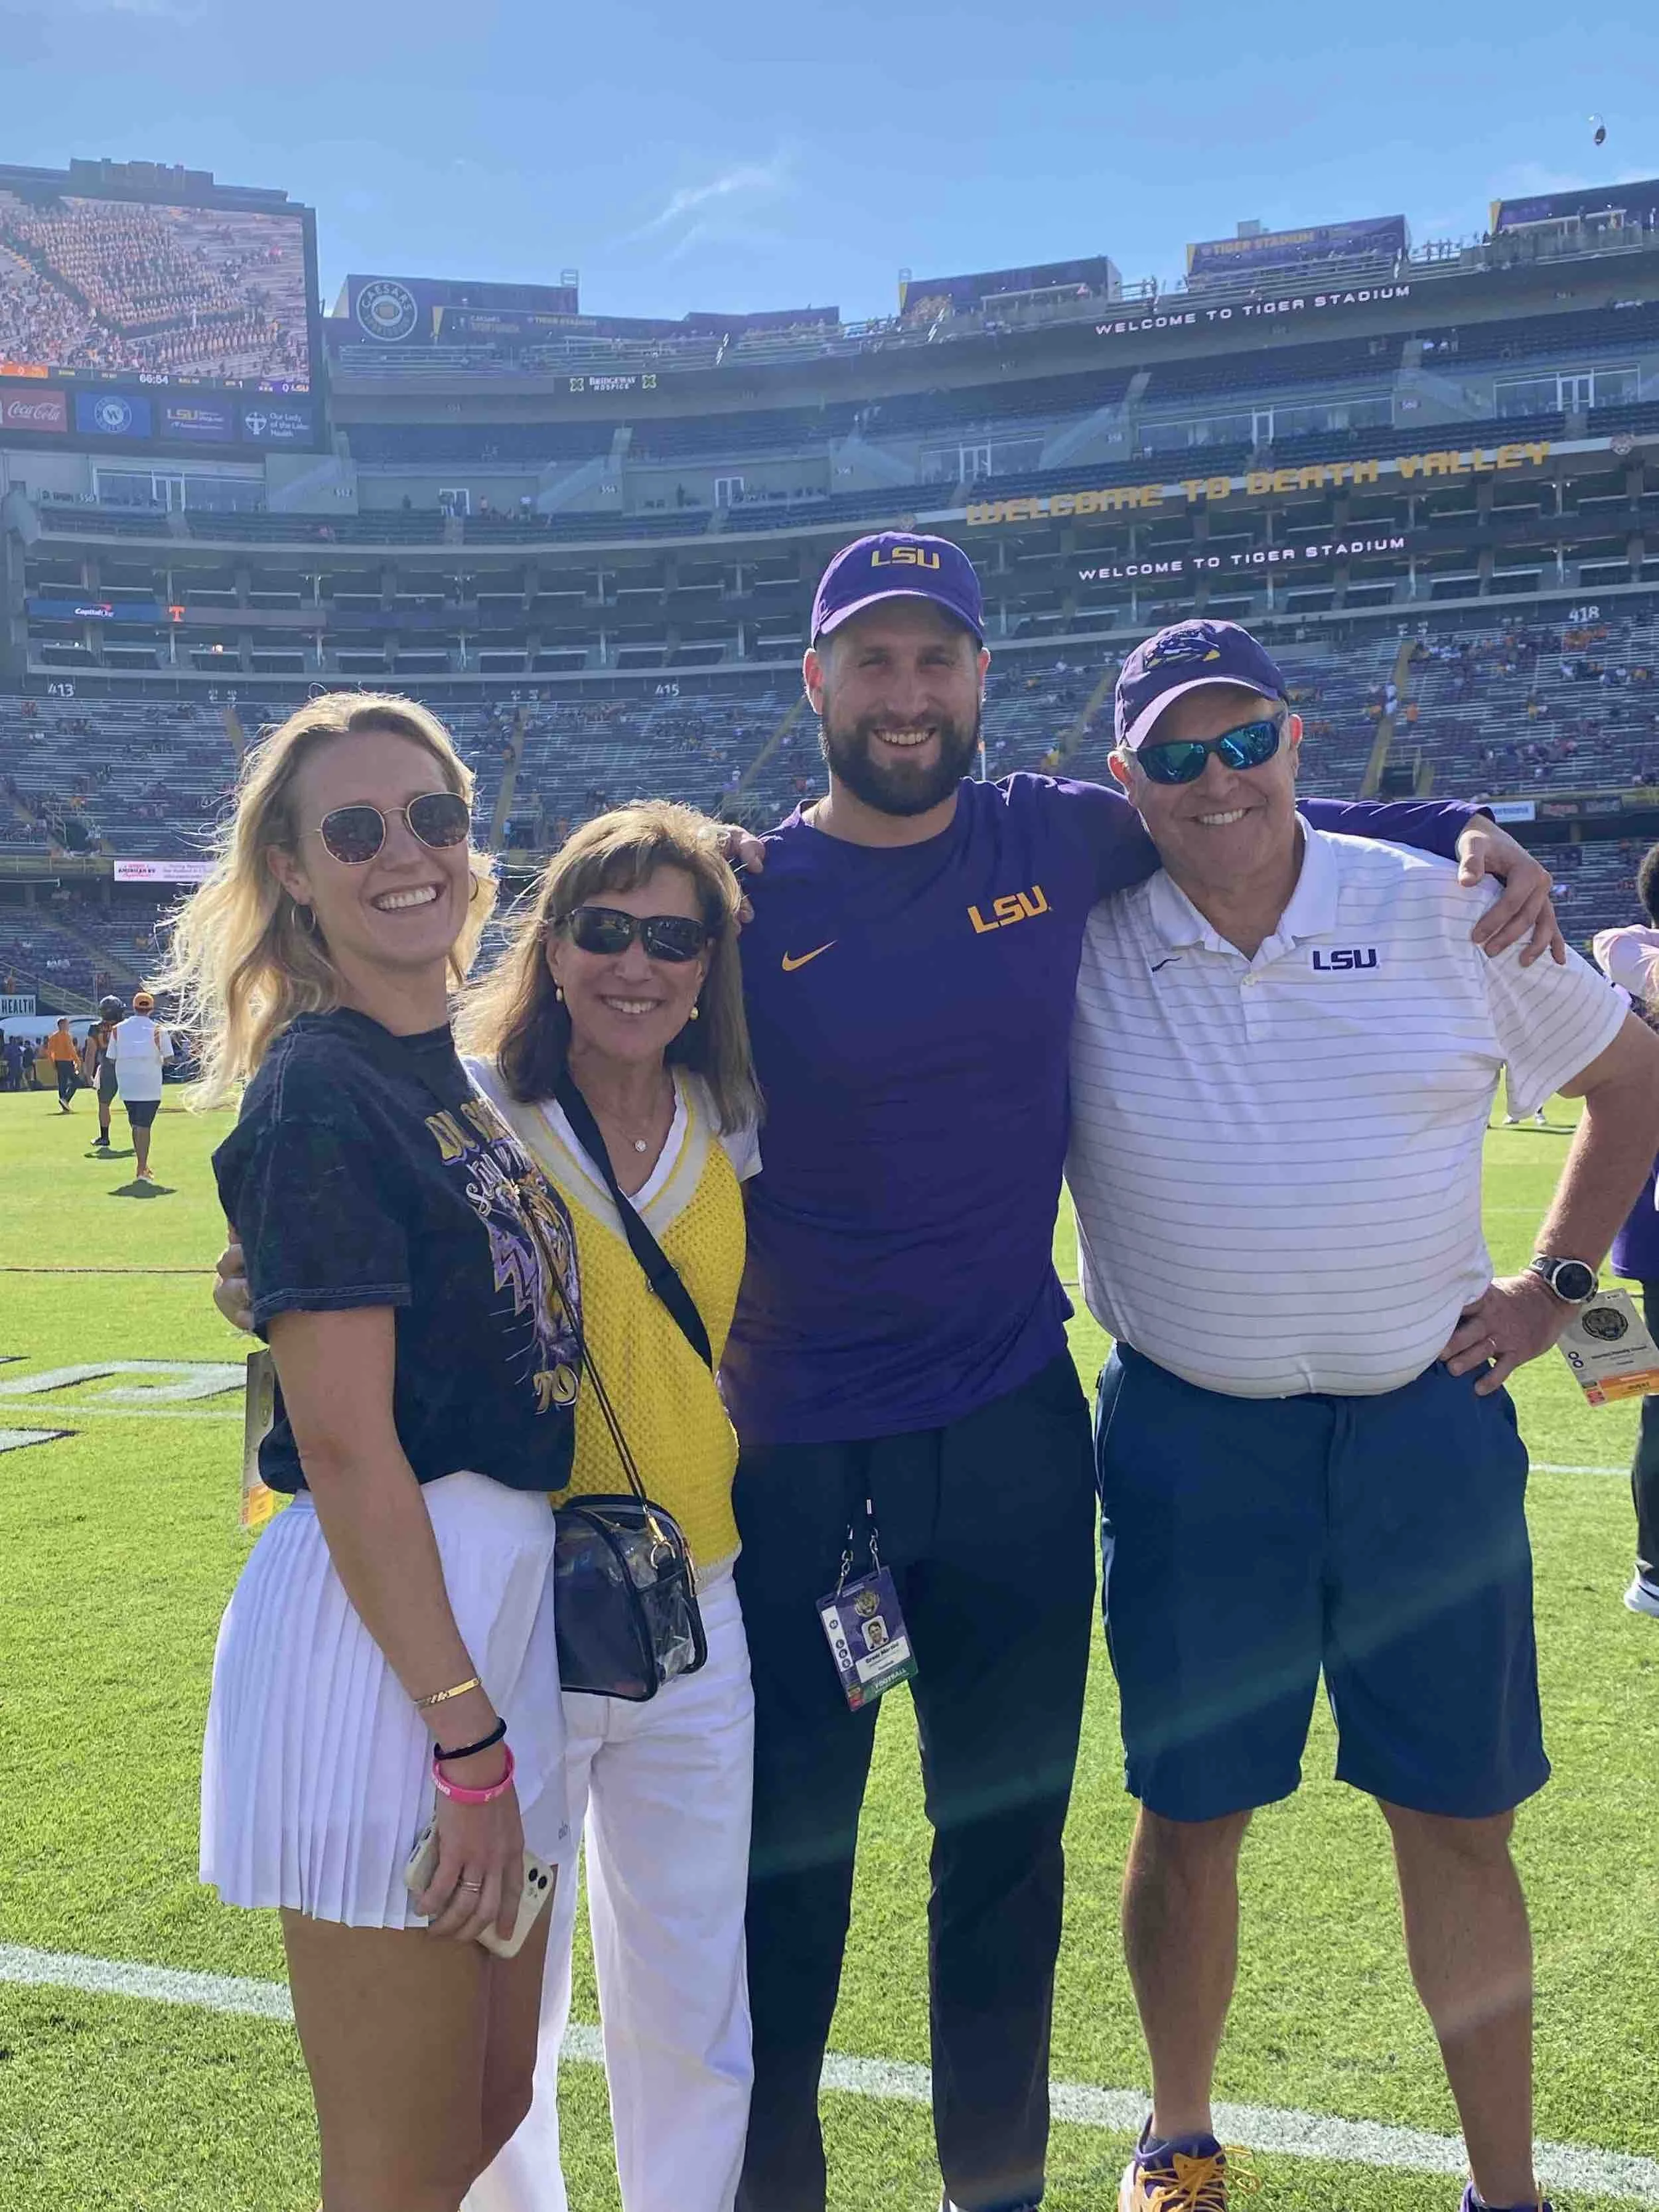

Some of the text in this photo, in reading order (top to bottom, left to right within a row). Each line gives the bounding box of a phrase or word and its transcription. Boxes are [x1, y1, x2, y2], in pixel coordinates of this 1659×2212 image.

[1214, 240, 1252, 256] TIGER
[1255, 232, 1315, 248] STADIUM
[361, 285, 412, 311] CAESARS
[1096, 285, 1411, 334] WELCOME TO TIGER STADIUM
[270, 412, 302, 423] Our Lady
[966, 441, 1551, 526] WELCOME TO DEATH VALLEY
[871, 546, 940, 569] LSU
[1079, 537, 1405, 580] WELCOME TO TIGER STADIUM
[1568, 606, 1600, 622] 418
[48, 683, 74, 697] 413
[655, 684, 680, 696] 415
[967, 885, 1048, 934] LSU
[1313, 948, 1377, 970] LSU
[1, 998, 35, 1014] HEALTH
